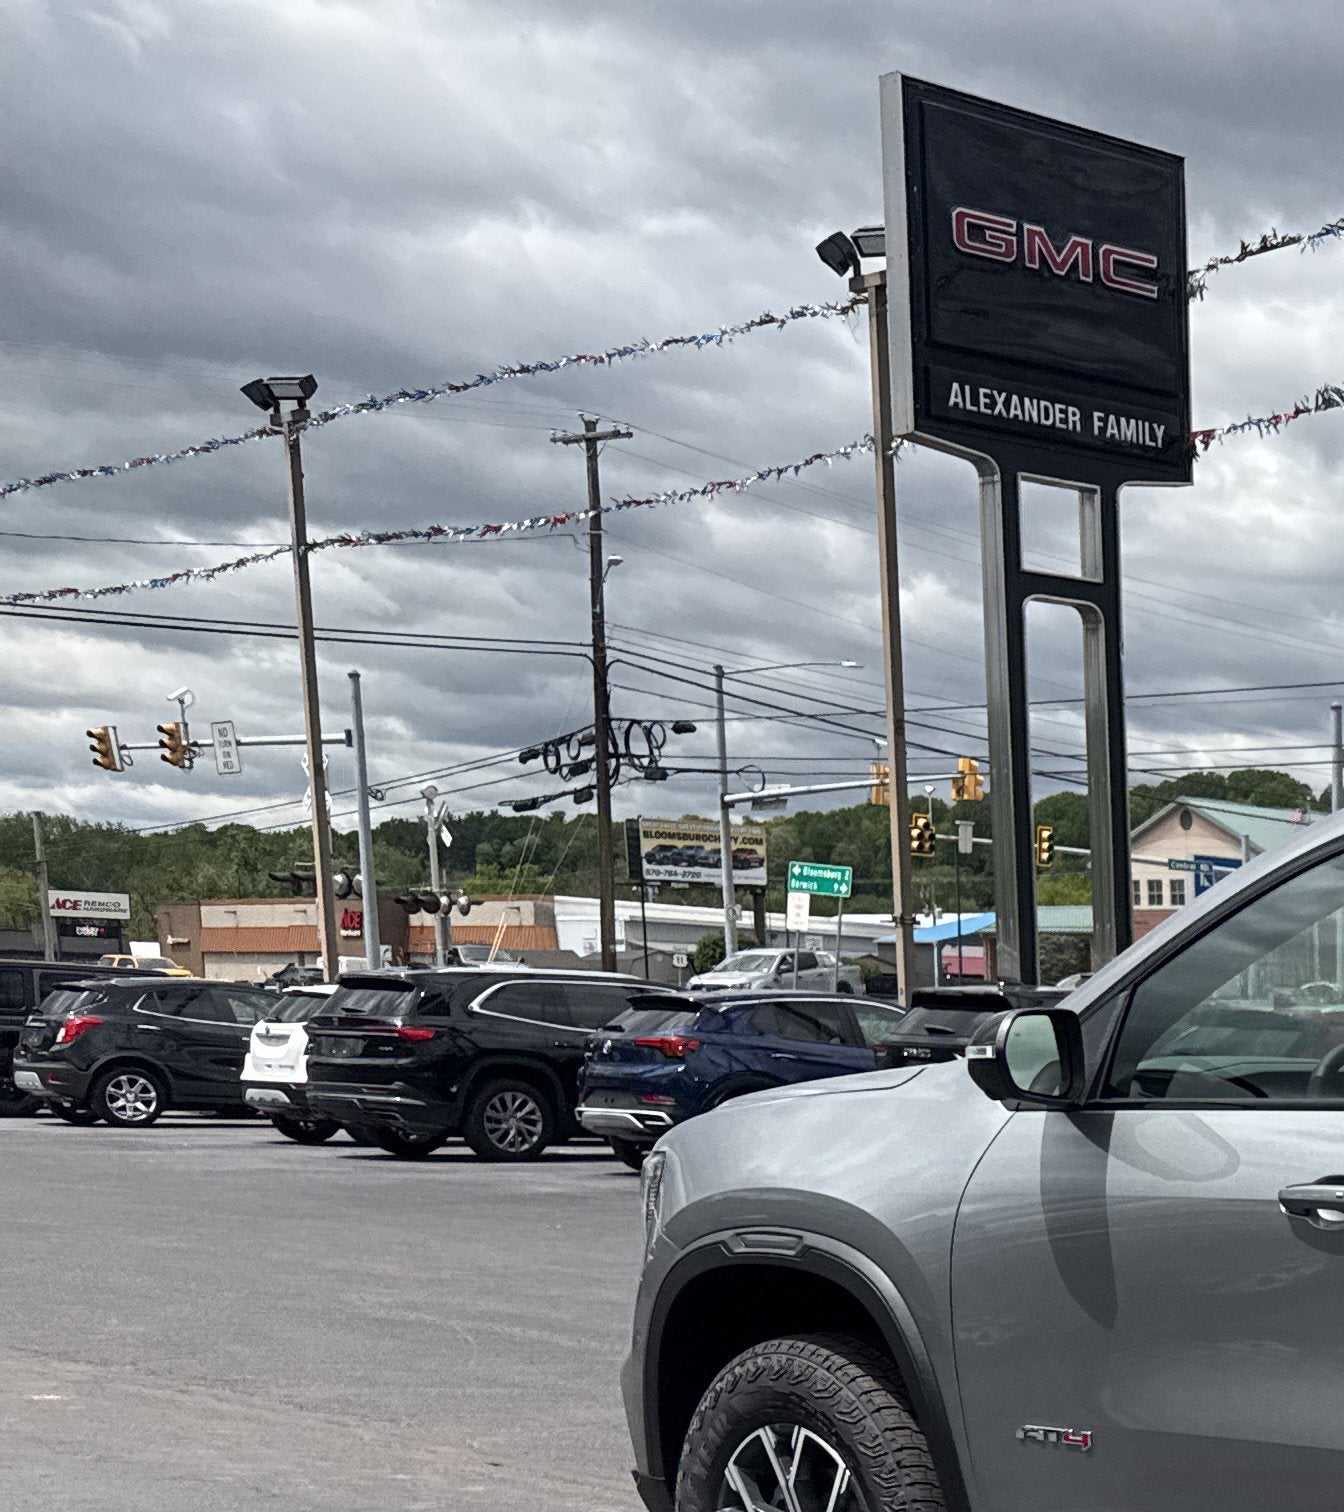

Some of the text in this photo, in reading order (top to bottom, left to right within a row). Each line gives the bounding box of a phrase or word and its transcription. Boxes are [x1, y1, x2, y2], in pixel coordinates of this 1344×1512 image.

[952, 206, 1158, 299] GMC
[948, 382, 1166, 449] ALEXANDER FAMILY
[643, 830, 763, 845] BLOOMSBURGCHY.COM
[50, 898, 82, 911] ACE
[341, 908, 362, 928] ACE
